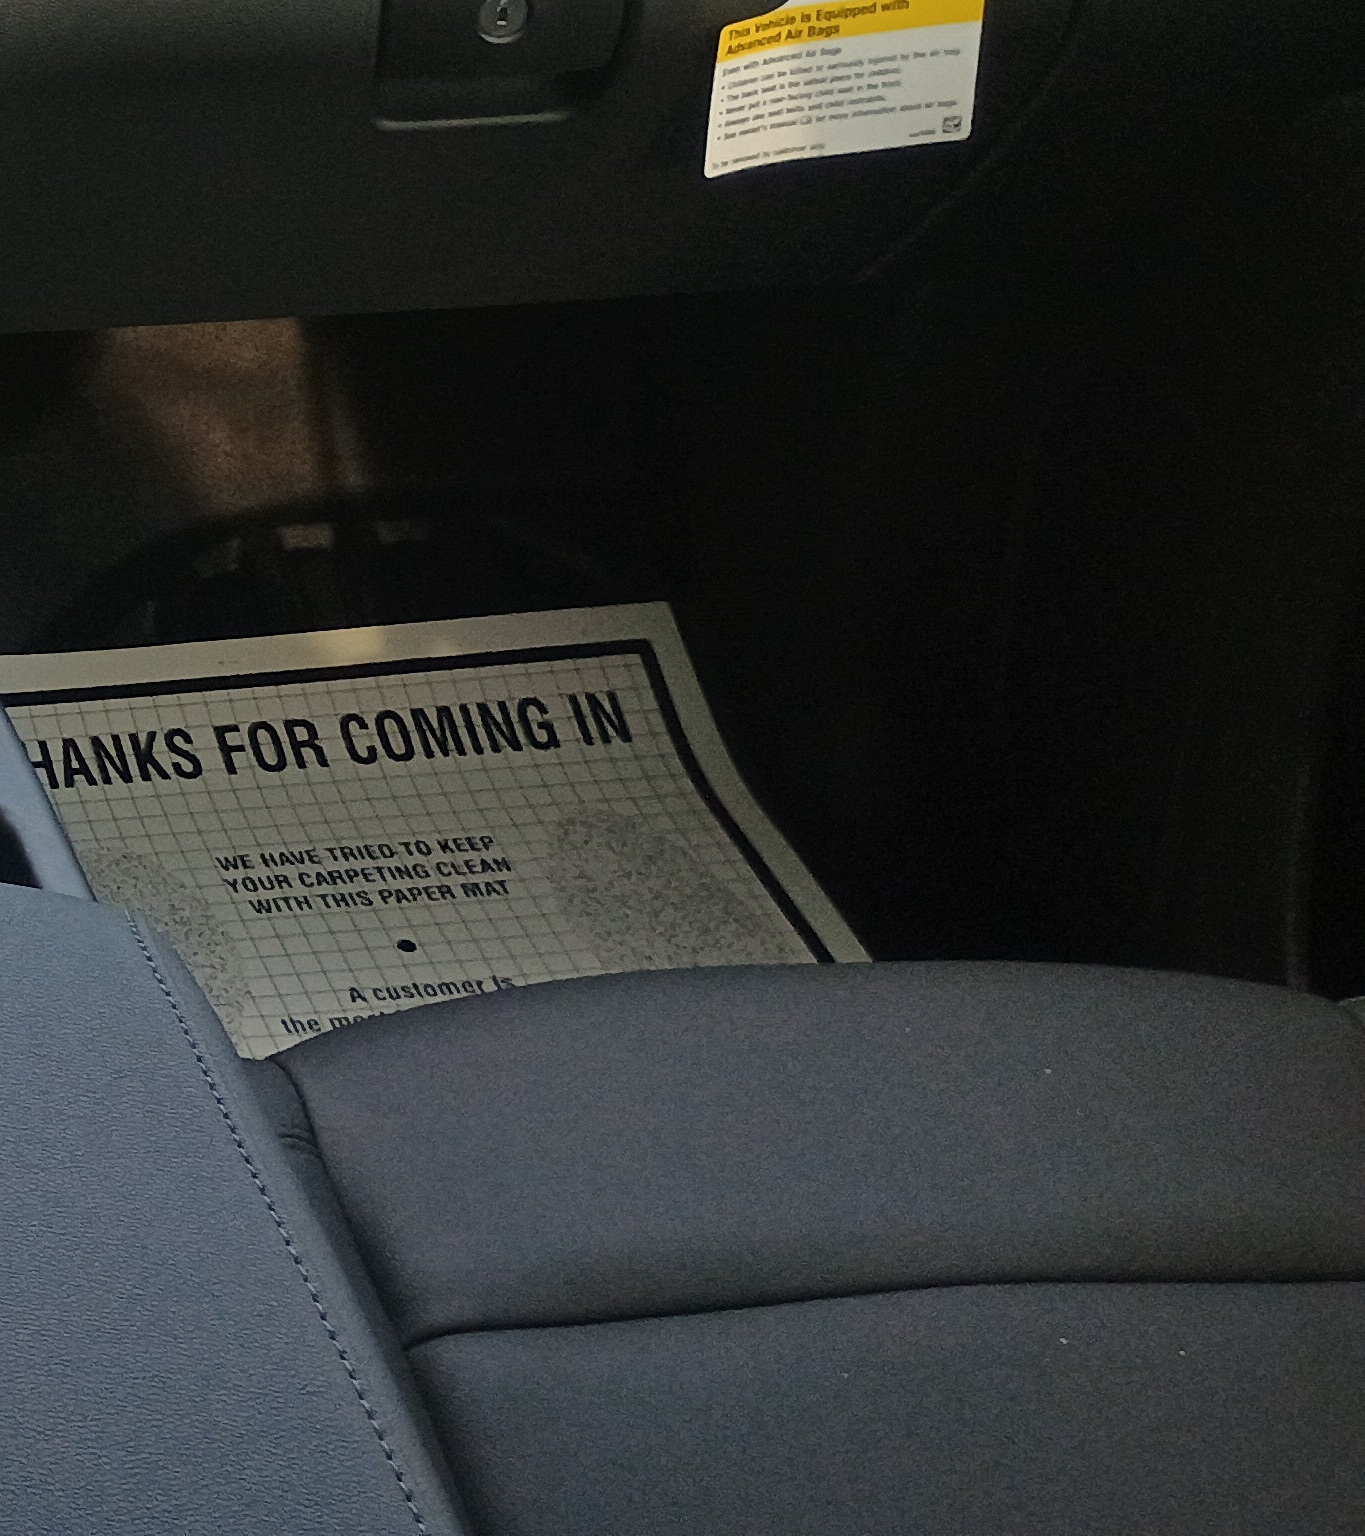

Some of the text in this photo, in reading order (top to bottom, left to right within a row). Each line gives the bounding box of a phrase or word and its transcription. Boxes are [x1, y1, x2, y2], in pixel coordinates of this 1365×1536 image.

[785, 28, 803, 41] Air
[807, 24, 841, 38] Bags
[800, 11, 812, 24] is
[31, 689, 633, 790] HANKS FOR COMING IN
[214, 834, 495, 871] WE HAVE TRIED TO KEEP
[223, 855, 513, 895] YOUR CARPETING CLEAN
[248, 878, 510, 915] WITH THIS PAPER MAT
[348, 985, 369, 1004] A
[372, 978, 485, 1002] customer
[280, 1016, 322, 1035] the
